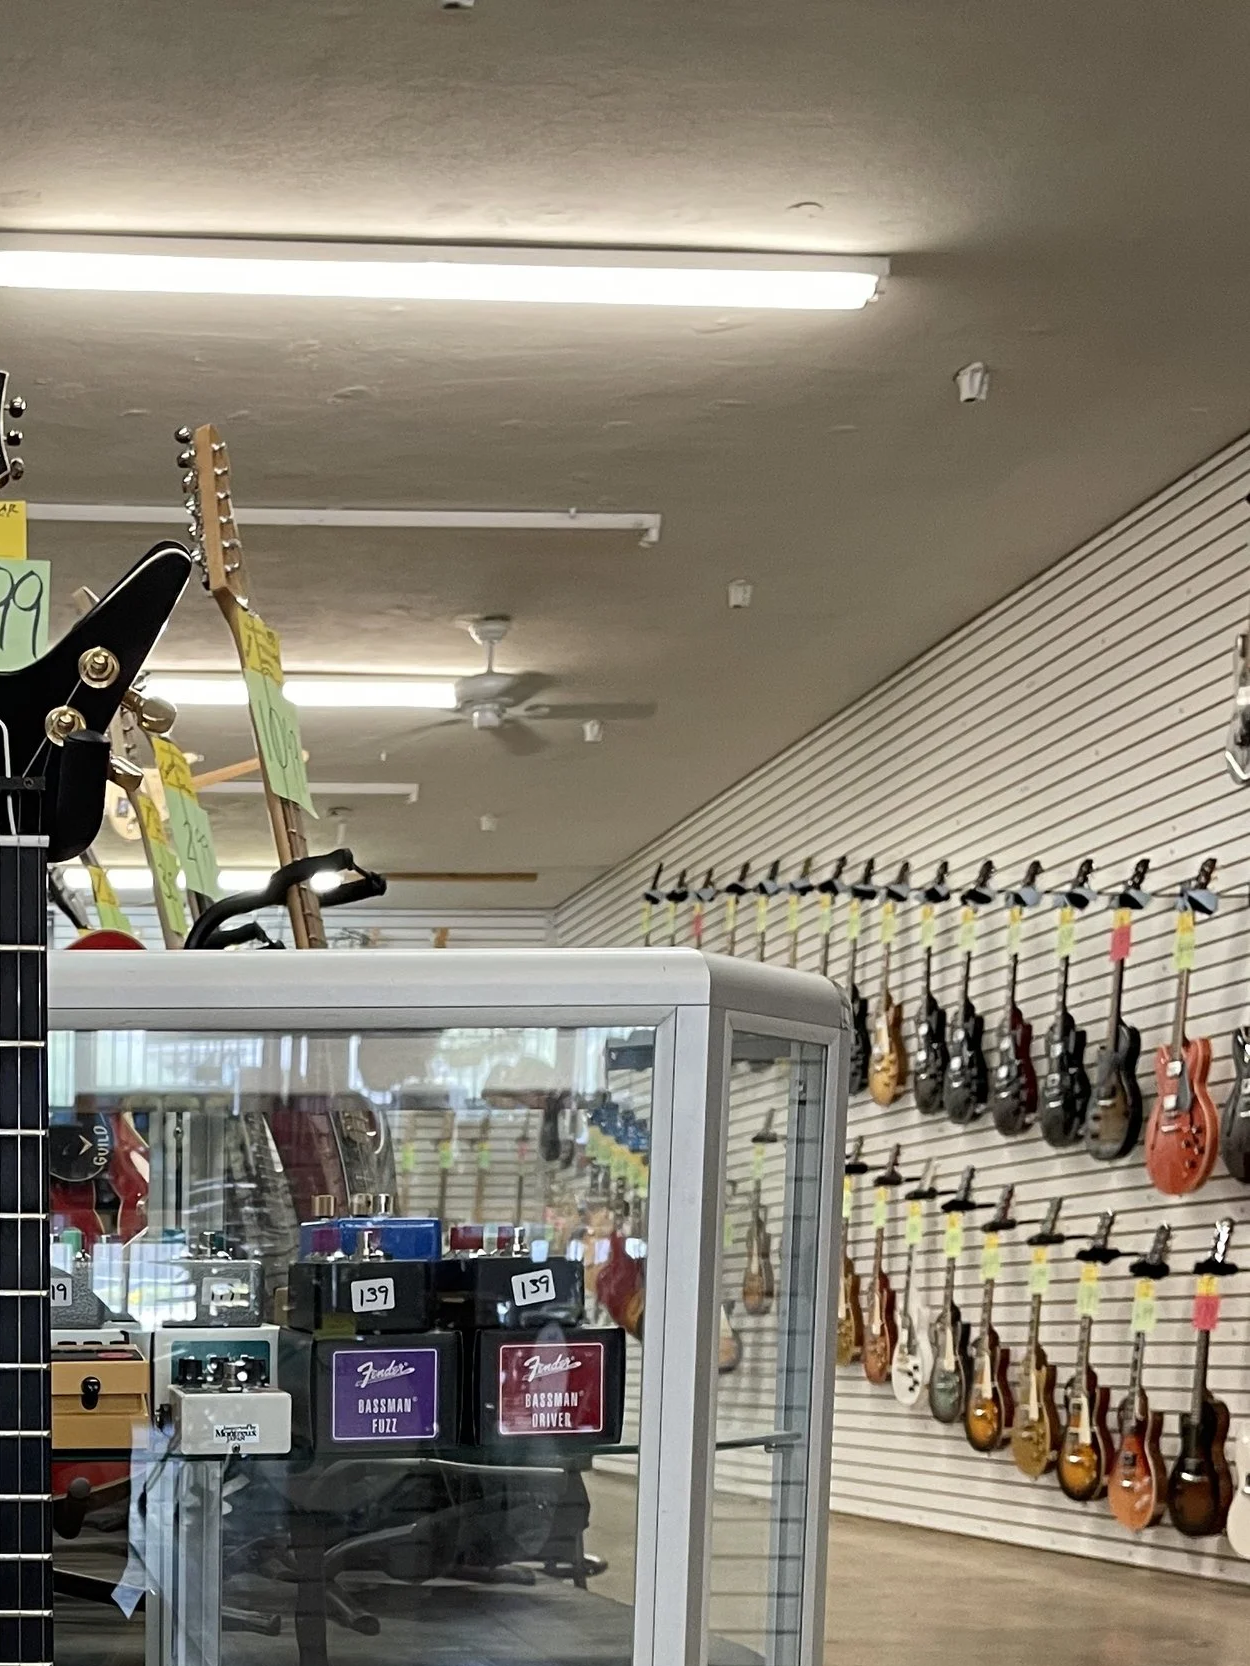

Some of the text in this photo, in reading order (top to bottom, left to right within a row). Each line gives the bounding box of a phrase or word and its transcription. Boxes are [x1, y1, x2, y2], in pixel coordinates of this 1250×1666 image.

[357, 1285, 389, 1307] 139
[519, 1275, 553, 1303] 139
[355, 1359, 416, 1389] Fender
[522, 1354, 582, 1383] Fender
[358, 1398, 412, 1414] BASSMAN
[525, 1392, 579, 1408] BASSMAN
[372, 1418, 398, 1434] FUZZ
[532, 1412, 572, 1429] DRIVER
